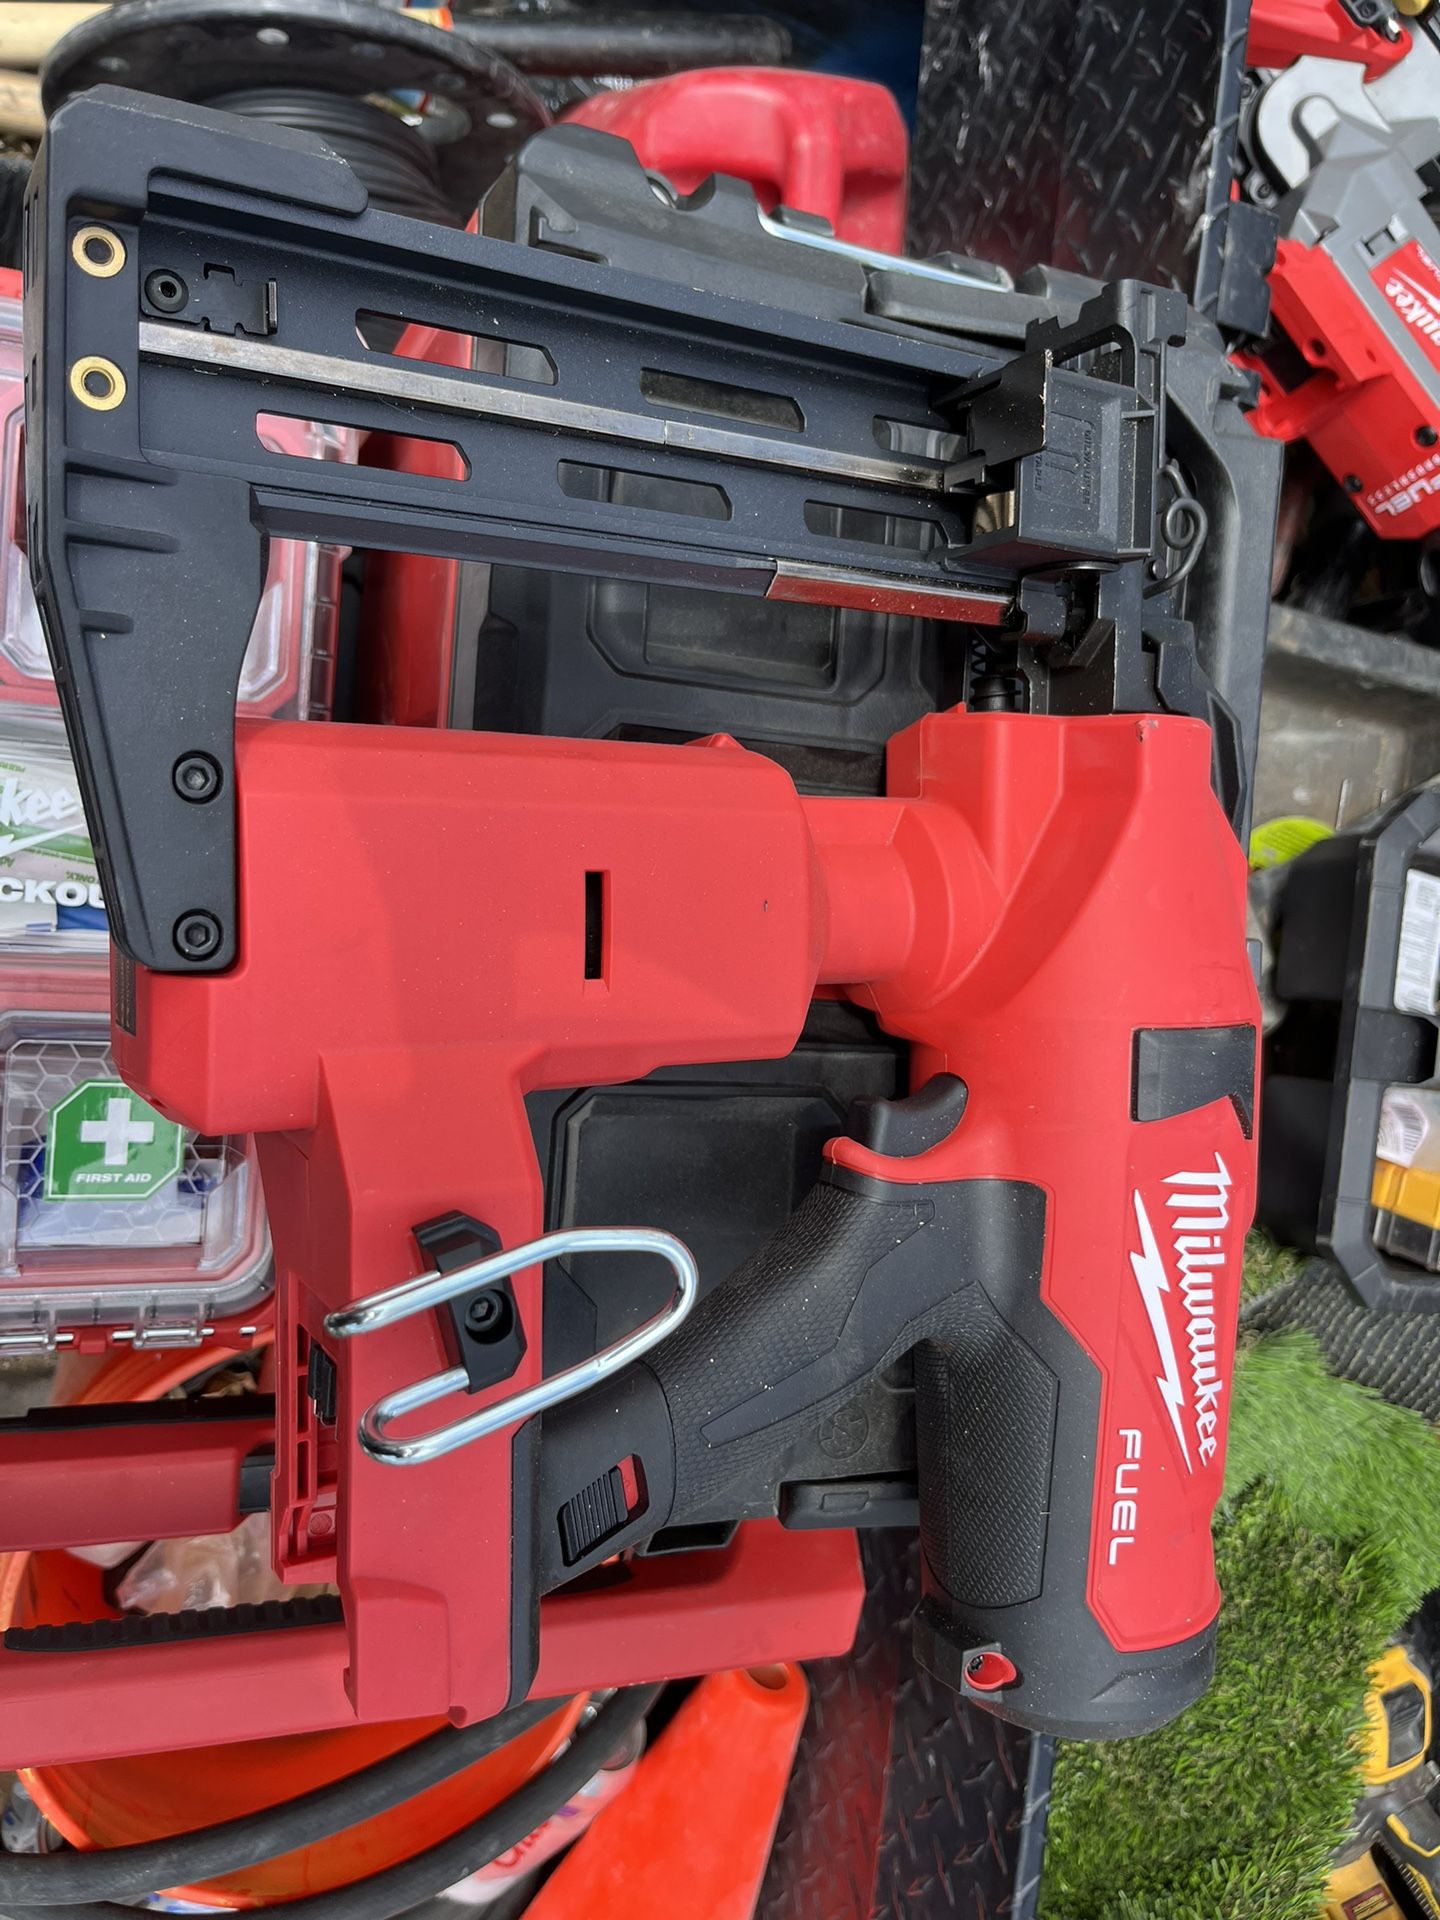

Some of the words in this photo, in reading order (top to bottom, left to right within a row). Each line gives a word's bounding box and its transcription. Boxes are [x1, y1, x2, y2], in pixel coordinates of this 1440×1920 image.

[75, 1172, 123, 1183] FIRST
[124, 1172, 152, 1183] AID
[1161, 1151, 1232, 1469] Milwaukee
[1108, 1428, 1142, 1565] FUEL
